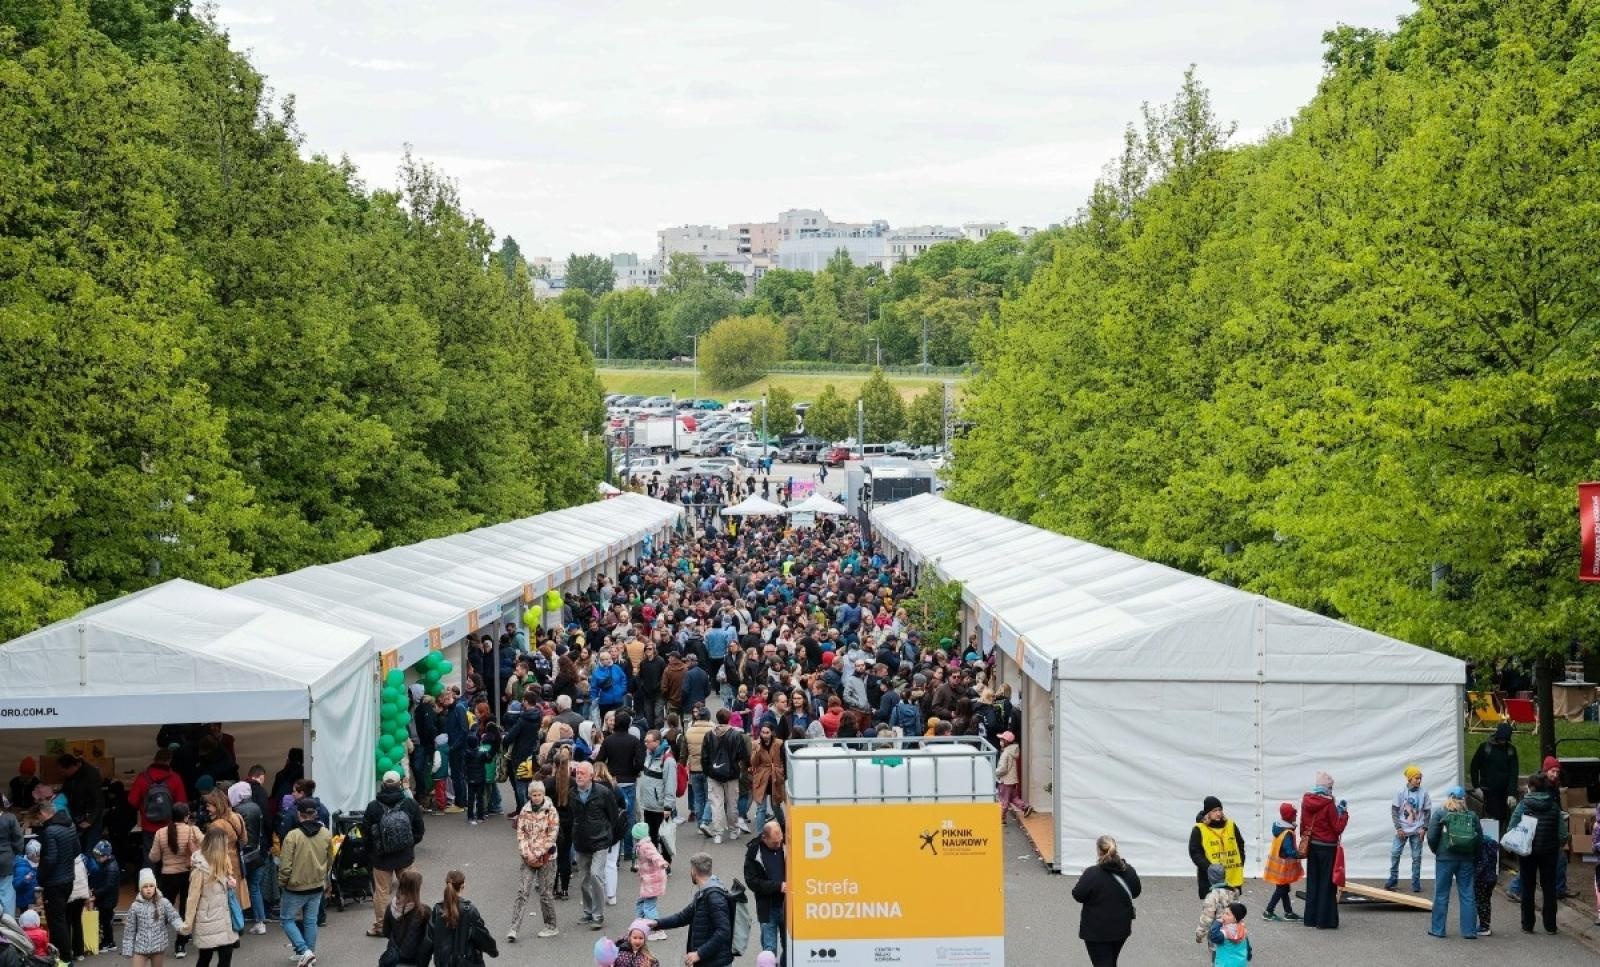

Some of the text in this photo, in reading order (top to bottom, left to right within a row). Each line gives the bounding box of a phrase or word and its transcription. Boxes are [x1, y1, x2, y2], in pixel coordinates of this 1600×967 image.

[804, 822, 832, 859] B
[942, 829, 973, 838] PIKNIK
[942, 838, 989, 847] NAUKOWY
[806, 878, 859, 895] Strefa
[806, 902, 903, 919] RODZINNA
